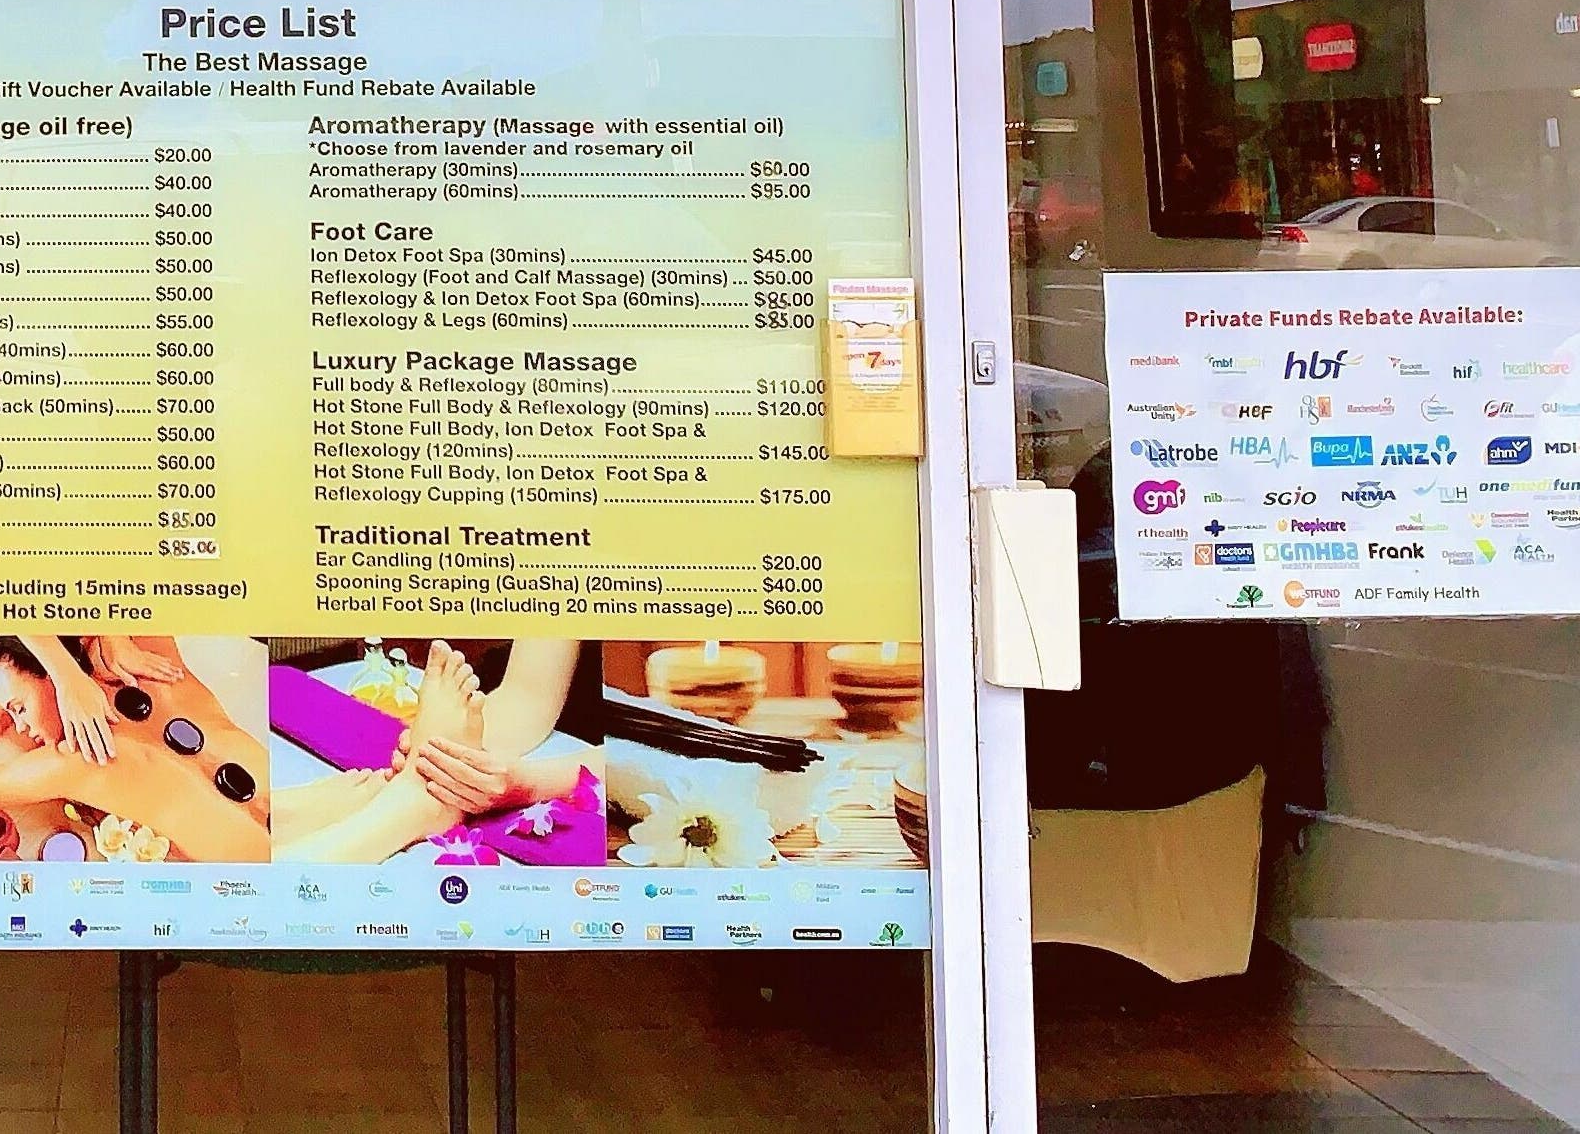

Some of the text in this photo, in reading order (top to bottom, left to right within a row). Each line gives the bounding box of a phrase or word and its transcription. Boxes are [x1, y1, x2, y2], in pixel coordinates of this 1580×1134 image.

[161, 6, 357, 39] Price List
[141, 51, 368, 76] The Best Massage
[27, 80, 114, 99] Voucher
[118, 79, 212, 98] Available
[230, 79, 296, 97] Health
[303, 79, 355, 97] Fund
[361, 79, 436, 97] Rebate
[440, 78, 537, 97] Available
[38, 116, 68, 136] oil
[75, 115, 133, 140] free)
[307, 114, 784, 139] Aromatherapy (Massage with essential oil)
[154, 146, 212, 165] $20.00
[393, 140, 438, 156] from
[444, 140, 528, 156] lavender
[532, 140, 569, 156] and
[574, 143, 665, 159] rosemary
[670, 140, 694, 156] oil
[308, 161, 438, 181] Aromatherapy
[442, 161, 518, 181] (30mins)
[154, 229, 213, 248] $50.00
[310, 221, 434, 242] Foot Care
[310, 246, 813, 267] Ion Detox Foot Spa (30mins) $45.00
[310, 268, 814, 289] Reflexology (Foot and Calf Massage) (30mins) $50.00
[1185, 306, 1524, 327] Private Funds Rebate Available:
[312, 350, 638, 375] Luxury Package Massage
[868, 351, 882, 368] 7
[1284, 350, 1349, 379] hbf
[312, 376, 344, 392] Full
[349, 376, 395, 396] body
[418, 376, 527, 397] Reflexology
[532, 377, 609, 397] (80mins)
[756, 377, 825, 398] $110.00
[1127, 403, 1175, 412] Australian
[1151, 411, 1175, 422] Unity
[313, 441, 828, 462] Reflexology (120mins) $145.00
[1147, 442, 1218, 462] Latrobe
[1230, 437, 1271, 456] HBA
[1313, 442, 1350, 456] Bupa
[1381, 444, 1429, 466] ANZ
[156, 453, 216, 472] $60.00
[314, 485, 831, 507] Reflexology Cupping (150mins) $175.00
[1341, 489, 1397, 502] NRMA
[314, 524, 592, 547] Traditional Treatment
[1291, 518, 1346, 536] Peoplecare
[1368, 542, 1424, 559] Frank
[315, 551, 823, 573] Ear Candling (10mins) $20.00
[74, 579, 147, 597] 15mins
[152, 579, 248, 600] massage)
[315, 572, 823, 596] Spooning Scraping (GuaSha) (20mins) $40.00
[1354, 586, 1480, 602] ADF Family Health
[2, 601, 153, 620] Hot Stone Free
[316, 595, 824, 619] Herbal Foot Spa (Including 20 mins massage) $60.00
